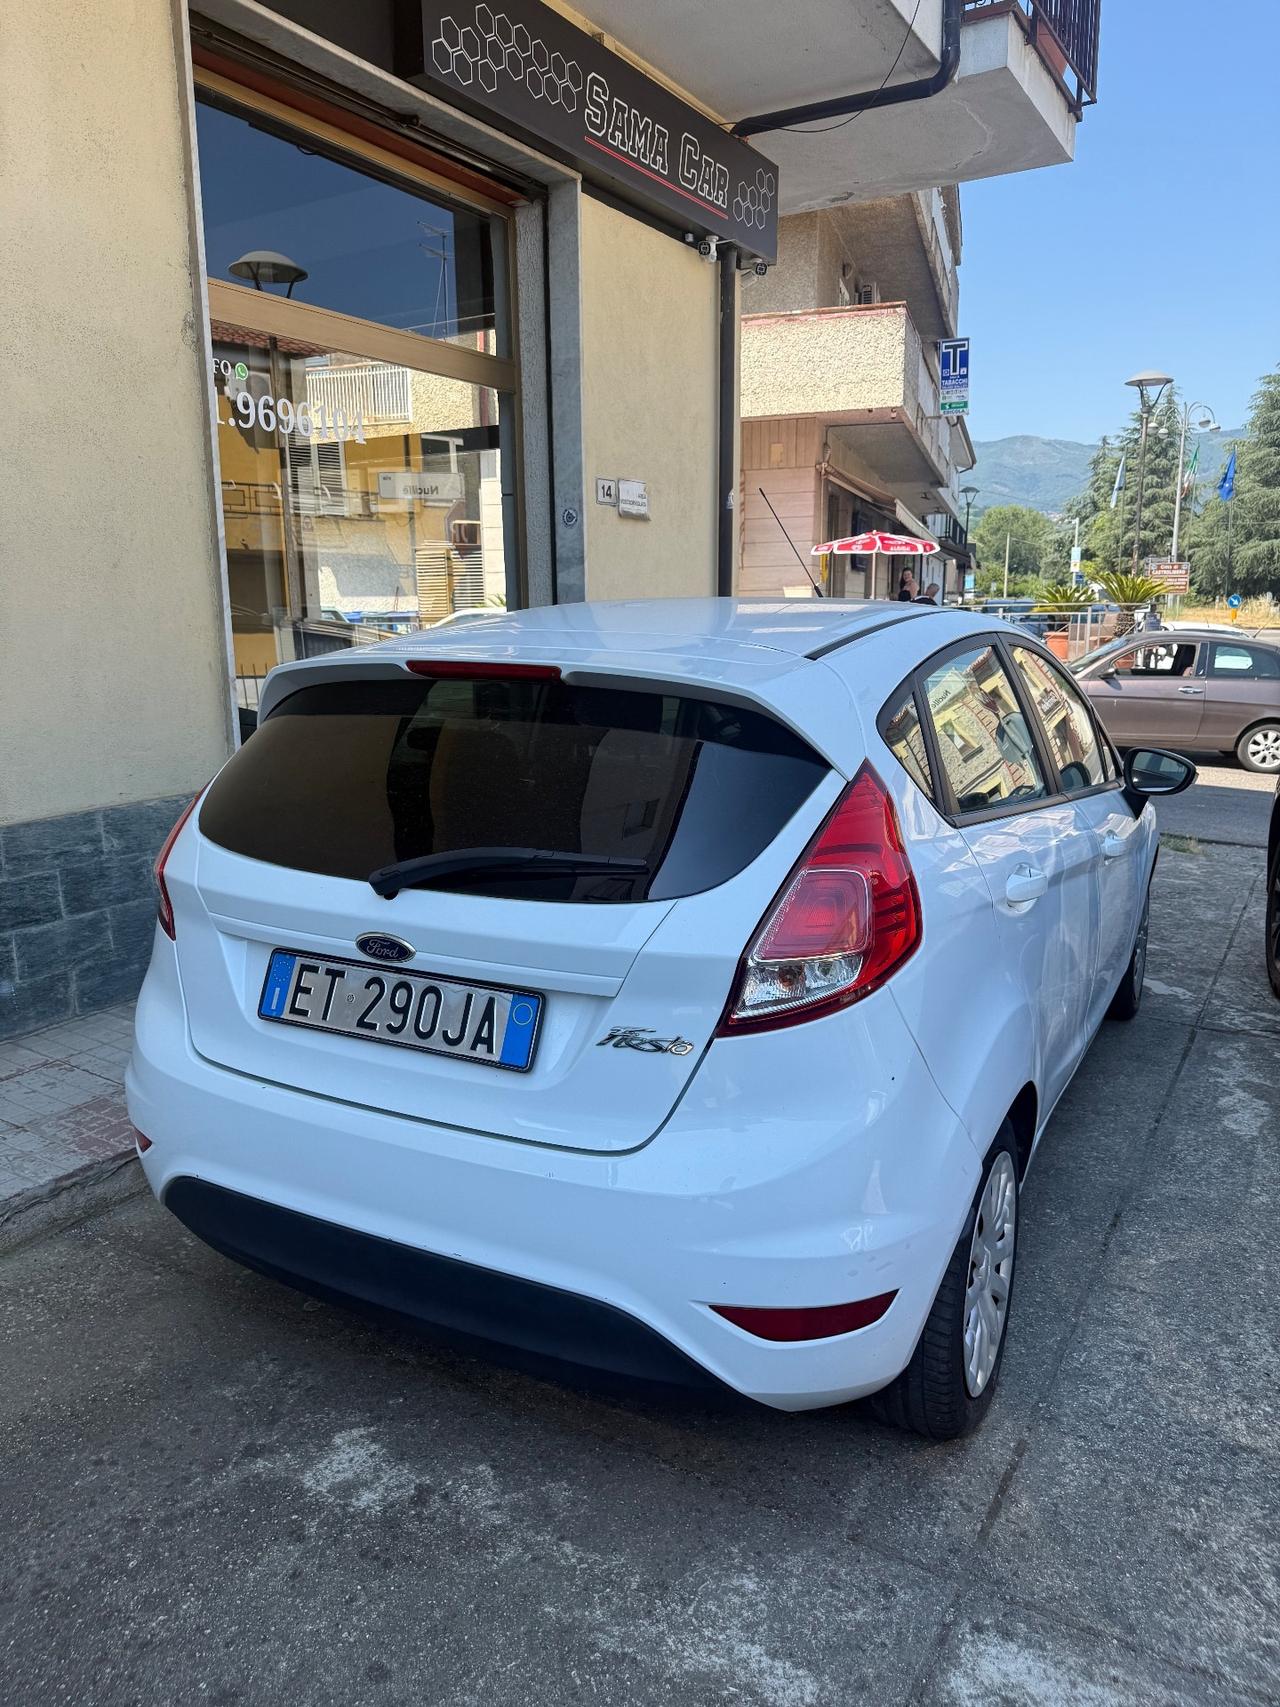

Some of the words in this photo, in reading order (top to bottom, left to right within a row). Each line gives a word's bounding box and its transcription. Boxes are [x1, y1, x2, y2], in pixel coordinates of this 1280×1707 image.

[942, 341, 968, 376] T
[941, 378, 968, 386] TABACCHI
[601, 484, 612, 499] 14
[366, 939, 399, 959] Ford
[288, 963, 346, 1021] ET
[356, 977, 497, 1055] 290JA
[595, 1026, 694, 1056] Fiesta
